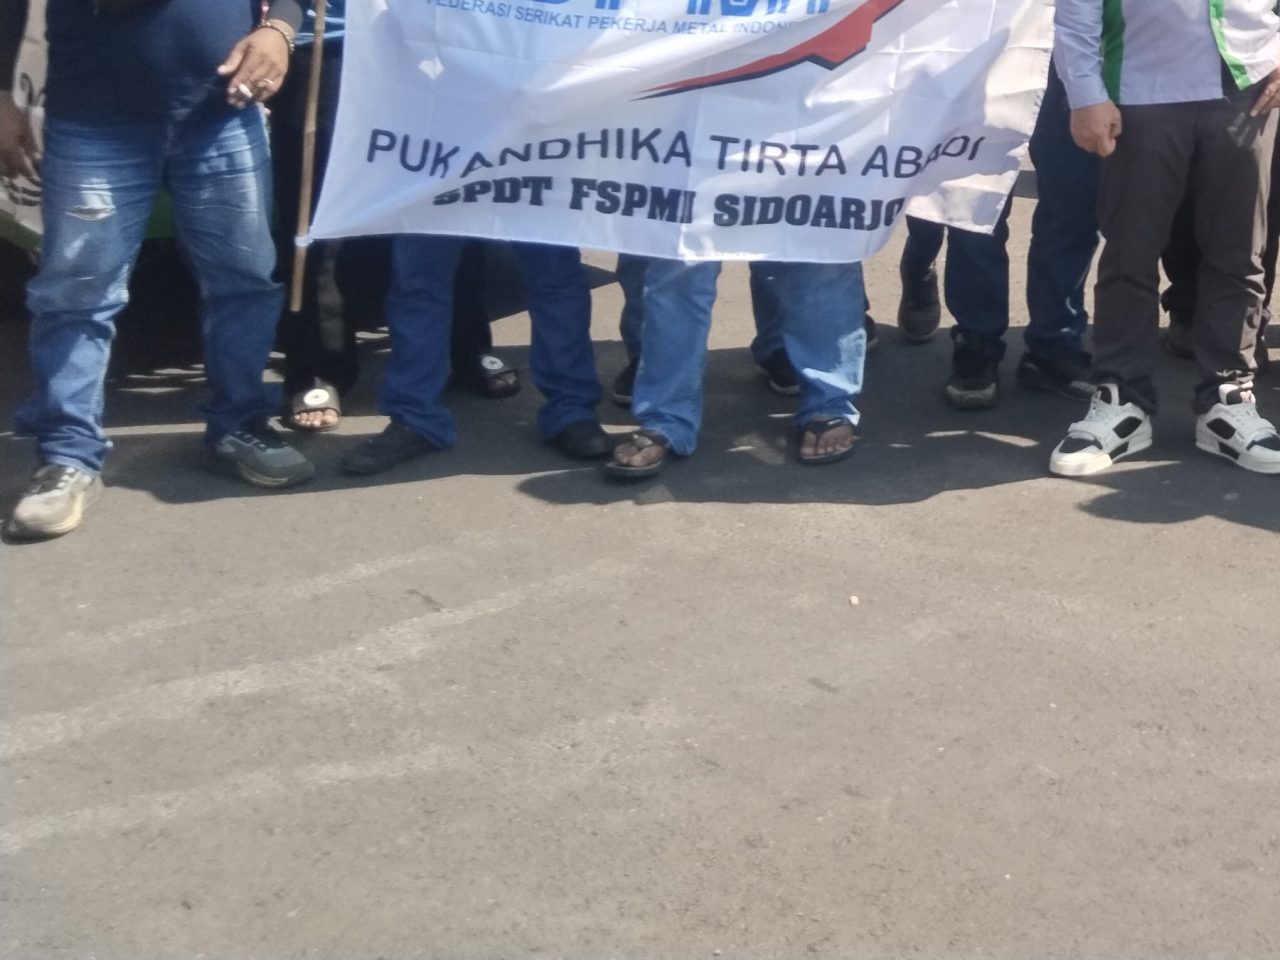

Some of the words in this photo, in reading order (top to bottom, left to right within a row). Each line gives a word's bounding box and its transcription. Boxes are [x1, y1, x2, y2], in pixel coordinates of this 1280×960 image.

[514, 6, 582, 29] SERIKAT
[587, 17, 667, 33] PEKERJA
[672, 20, 726, 35] METAL
[366, 128, 460, 178] PUK
[460, 127, 692, 178] ANDHIKA
[710, 135, 847, 177] TIRTA
[860, 135, 986, 178] ABADI
[433, 176, 553, 206] SPDT
[569, 177, 696, 224] FSPMI
[713, 193, 905, 231] SIDOARJO
